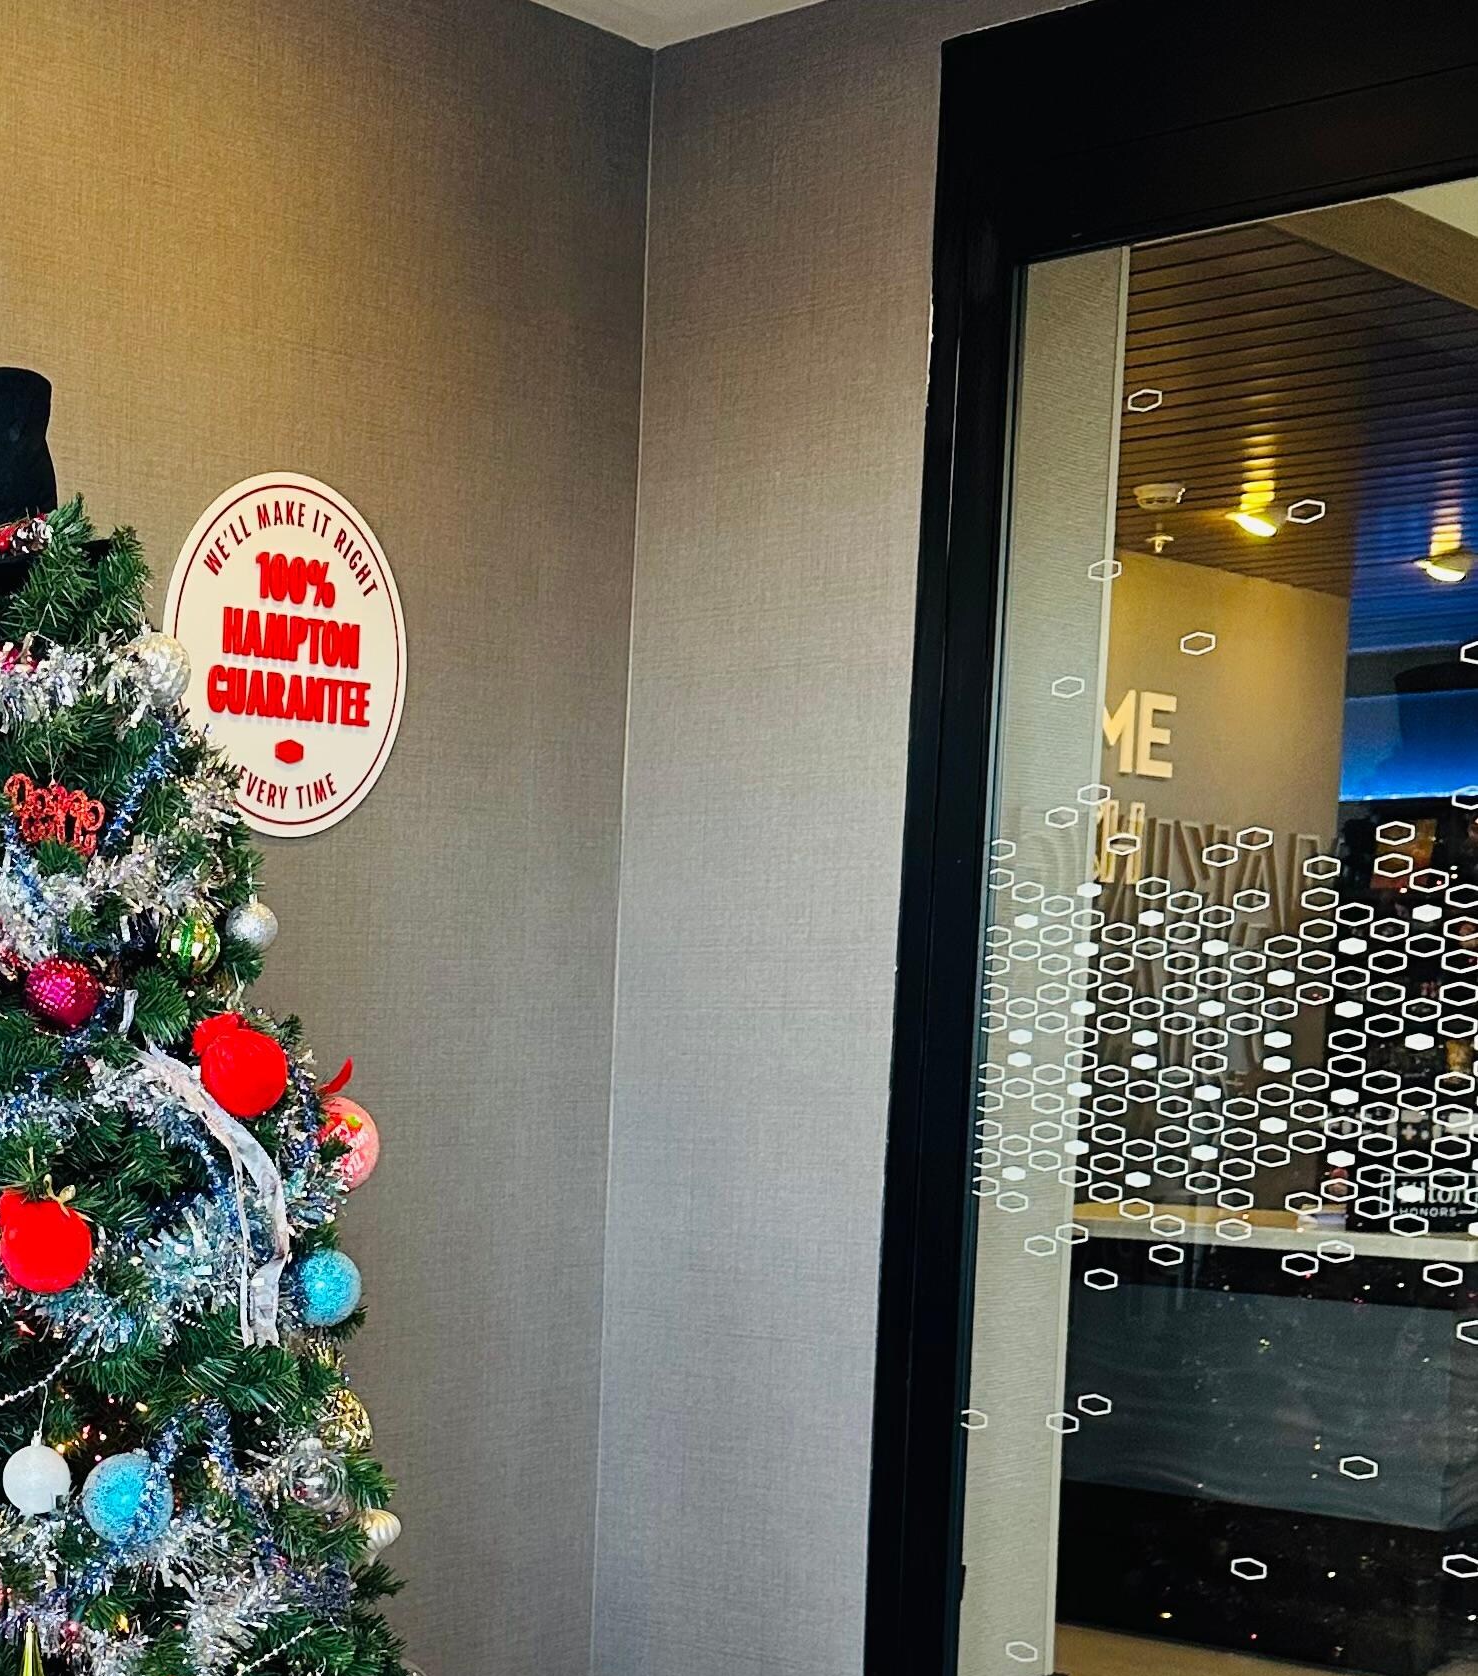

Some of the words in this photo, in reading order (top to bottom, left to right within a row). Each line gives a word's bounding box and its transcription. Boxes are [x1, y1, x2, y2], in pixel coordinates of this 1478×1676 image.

[203, 515, 253, 577] WE'LL
[256, 500, 306, 531] MAKE
[312, 508, 332, 539] IT
[333, 527, 379, 598] RIGHT
[255, 551, 337, 610] 100%
[222, 606, 360, 671] HAMPTON
[206, 664, 372, 728] GUARANTEE
[238, 764, 289, 810] EVERY
[295, 772, 338, 810] TIME
[1398, 1206, 1458, 1218] HONORS
